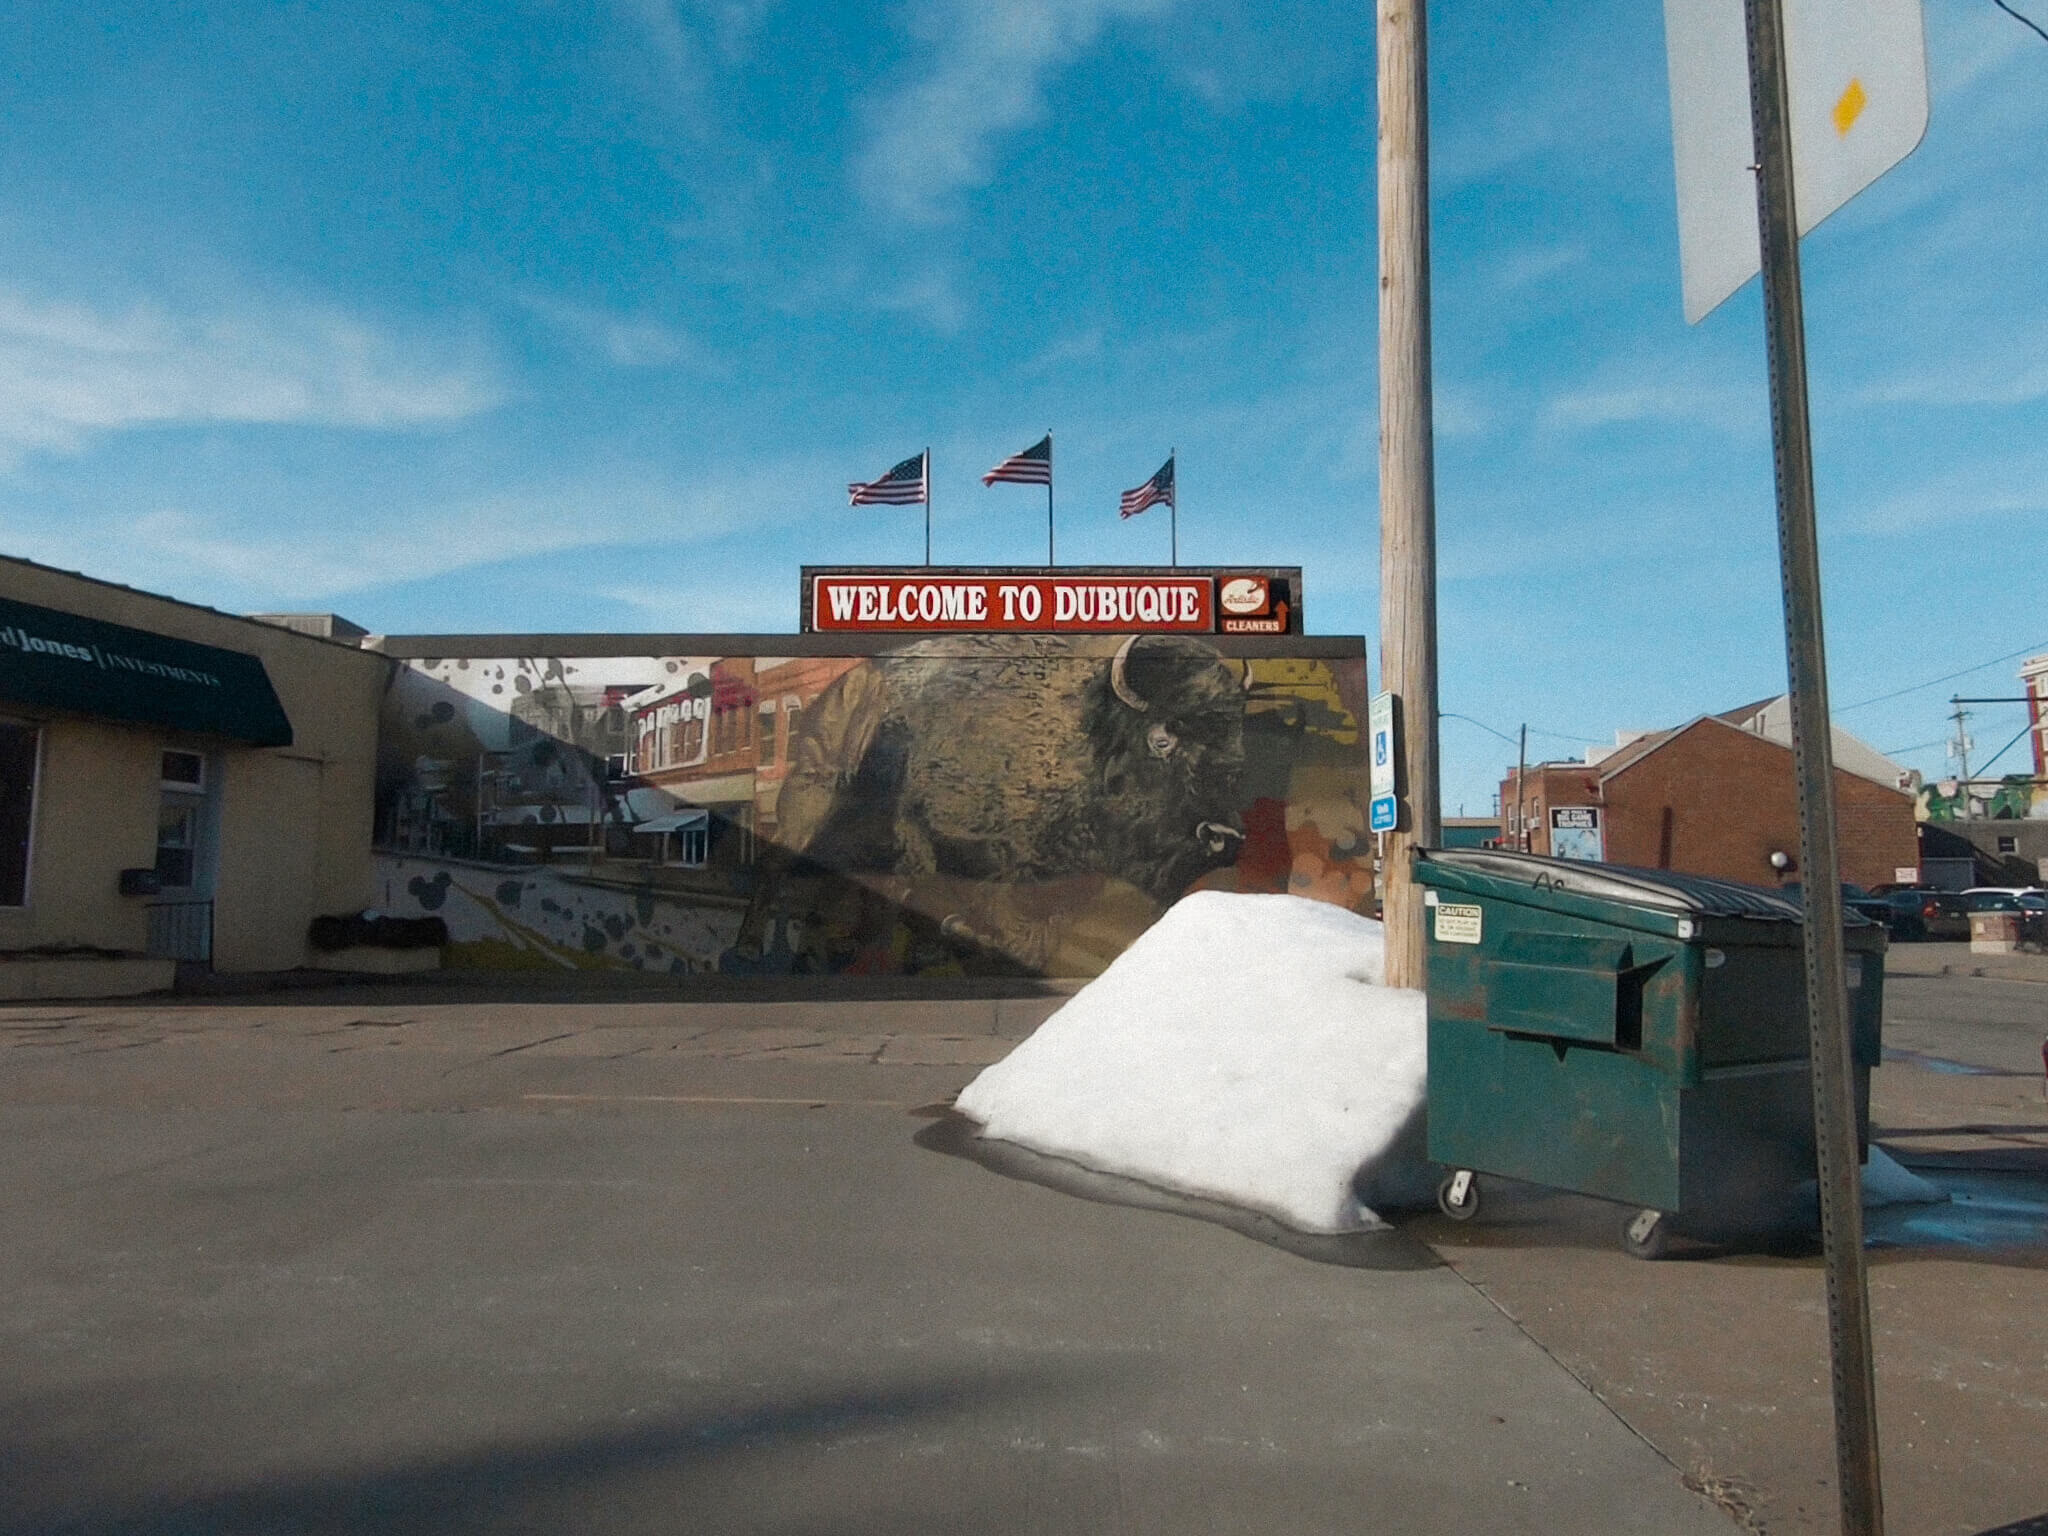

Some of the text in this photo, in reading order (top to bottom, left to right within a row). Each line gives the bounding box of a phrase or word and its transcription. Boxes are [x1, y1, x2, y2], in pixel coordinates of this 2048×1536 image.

[827, 584, 1200, 622] WELCOME TO DUBUQUE
[1226, 620, 1279, 632] CLEANERS
[1439, 905, 1480, 917] CAUTION
